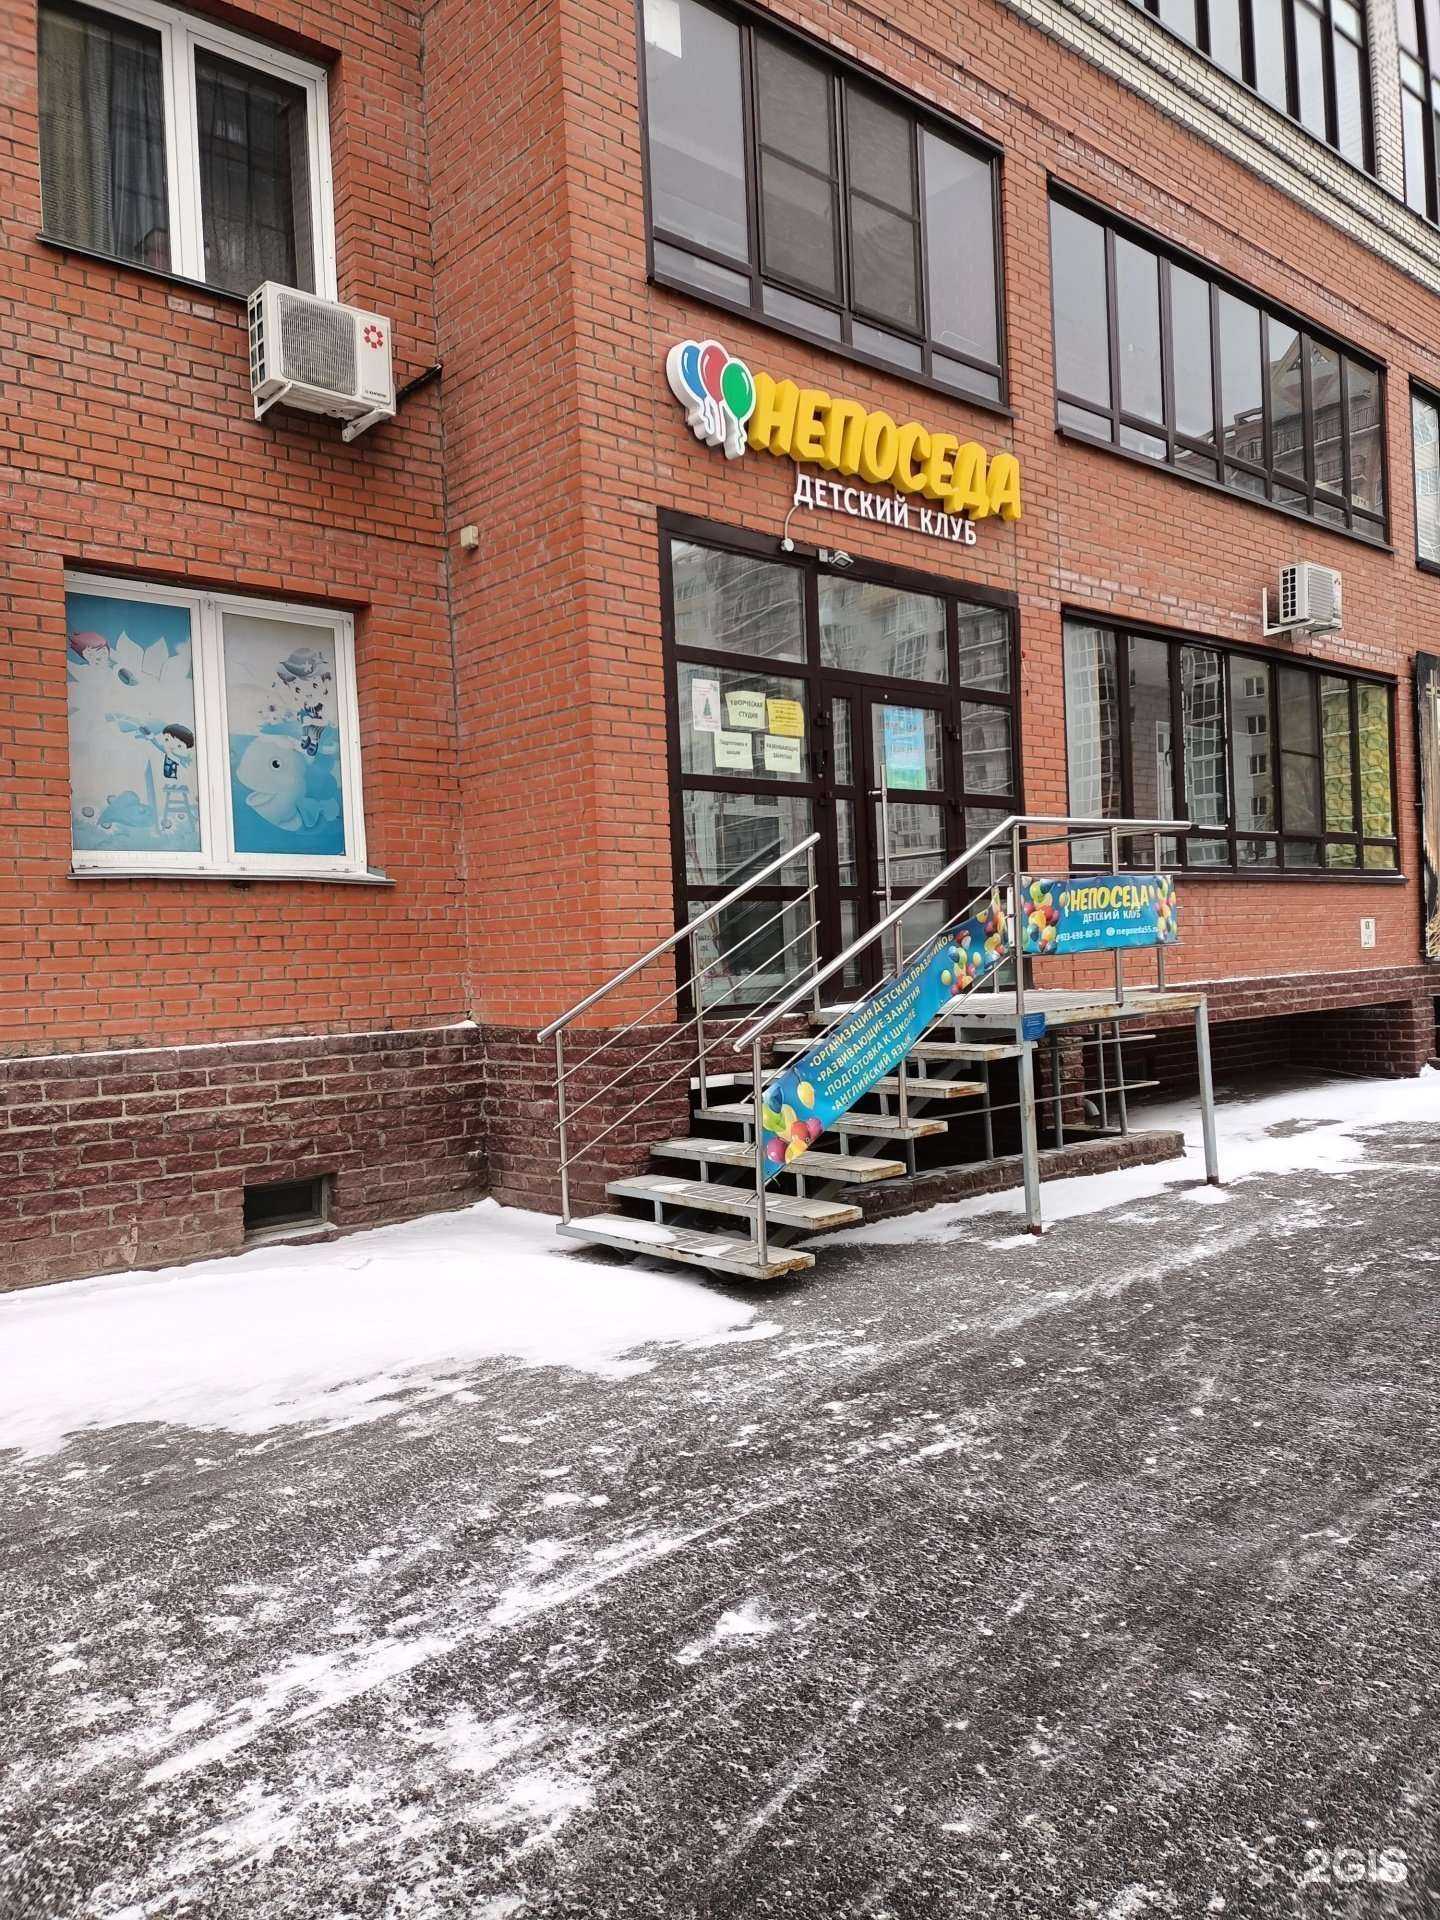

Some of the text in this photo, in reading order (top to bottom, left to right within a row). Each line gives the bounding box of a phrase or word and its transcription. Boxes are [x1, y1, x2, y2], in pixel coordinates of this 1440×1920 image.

[749, 371, 1022, 522] НЕПОСЕДА
[793, 473, 978, 547] ДЕТСКИЙ КЛУБ
[1069, 885, 1150, 911] НЕПОСЕДА
[1082, 909, 1142, 925] ДЕТСКИЙ КЛУБ
[884, 985, 921, 1026] ЗАНЯТИЯ
[883, 1034, 892, 1045] К
